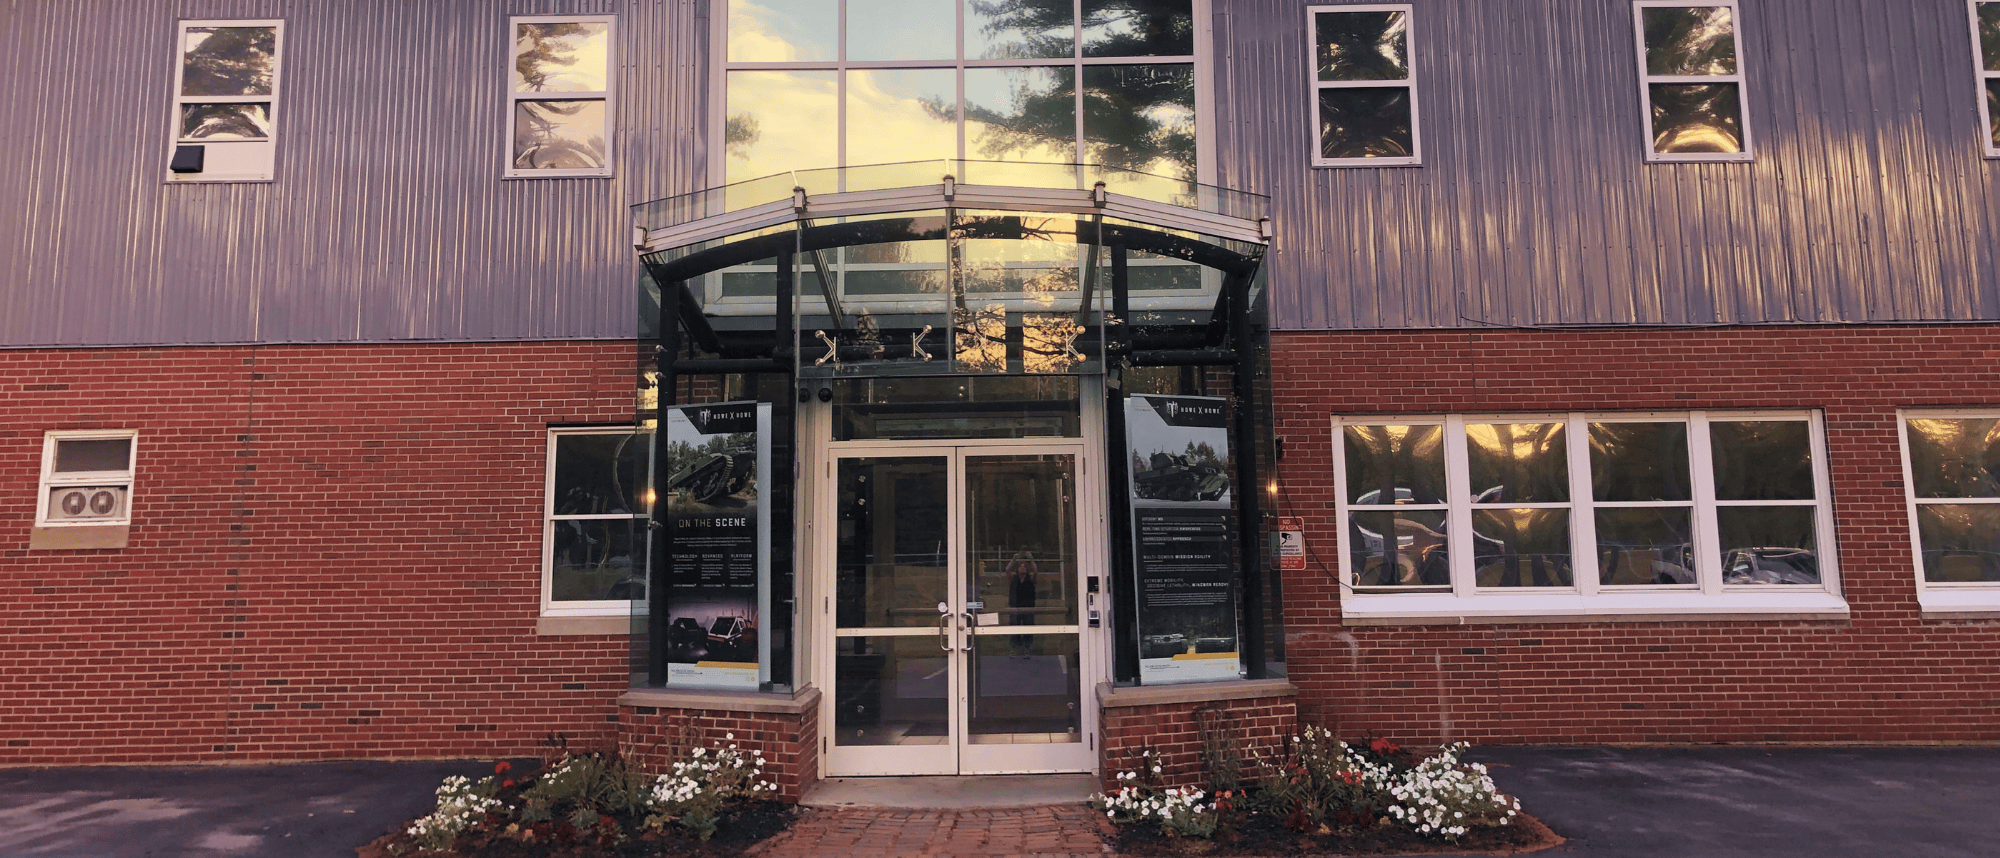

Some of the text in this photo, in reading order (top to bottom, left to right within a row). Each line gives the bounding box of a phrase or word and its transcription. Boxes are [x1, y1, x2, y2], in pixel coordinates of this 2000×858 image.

[678, 518, 746, 528] ON THE SCENE
